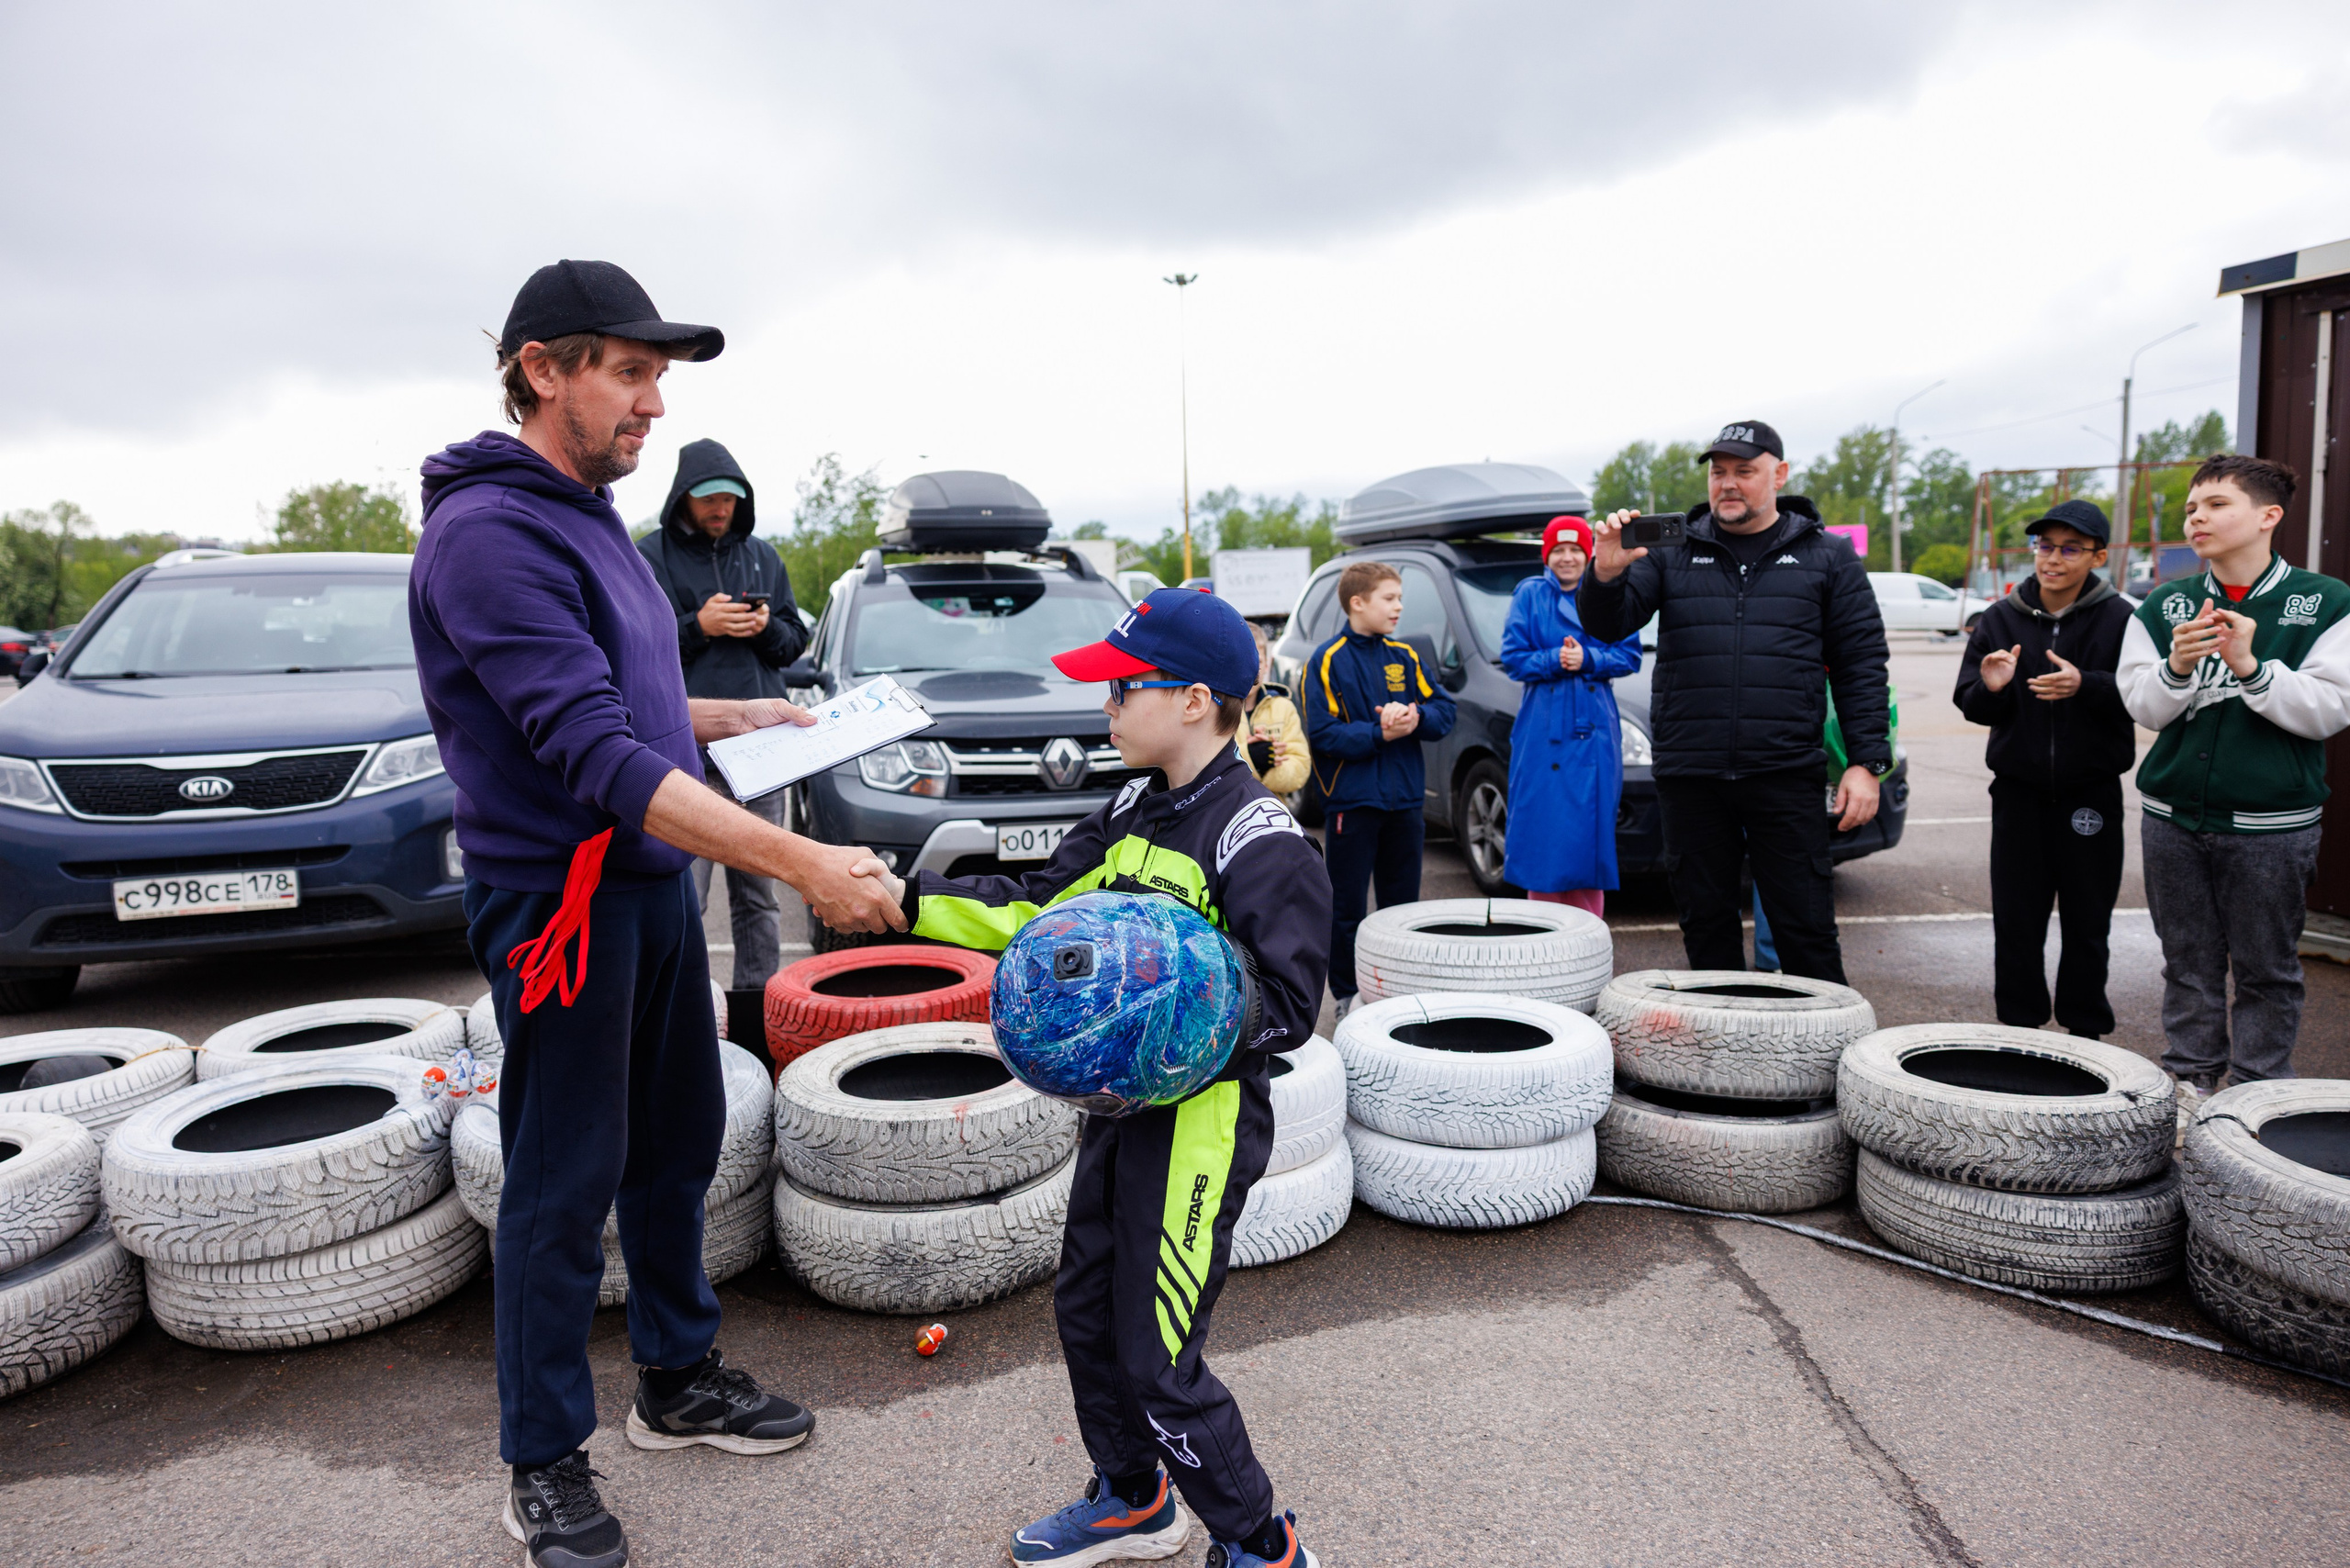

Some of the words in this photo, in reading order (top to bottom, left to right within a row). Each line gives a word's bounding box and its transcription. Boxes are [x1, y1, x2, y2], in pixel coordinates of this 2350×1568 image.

[187, 780, 225, 797] KIA
[247, 873, 289, 893] 178
[1149, 874, 1190, 899] ASTARS
[1181, 1173, 1209, 1253] ASTARS
